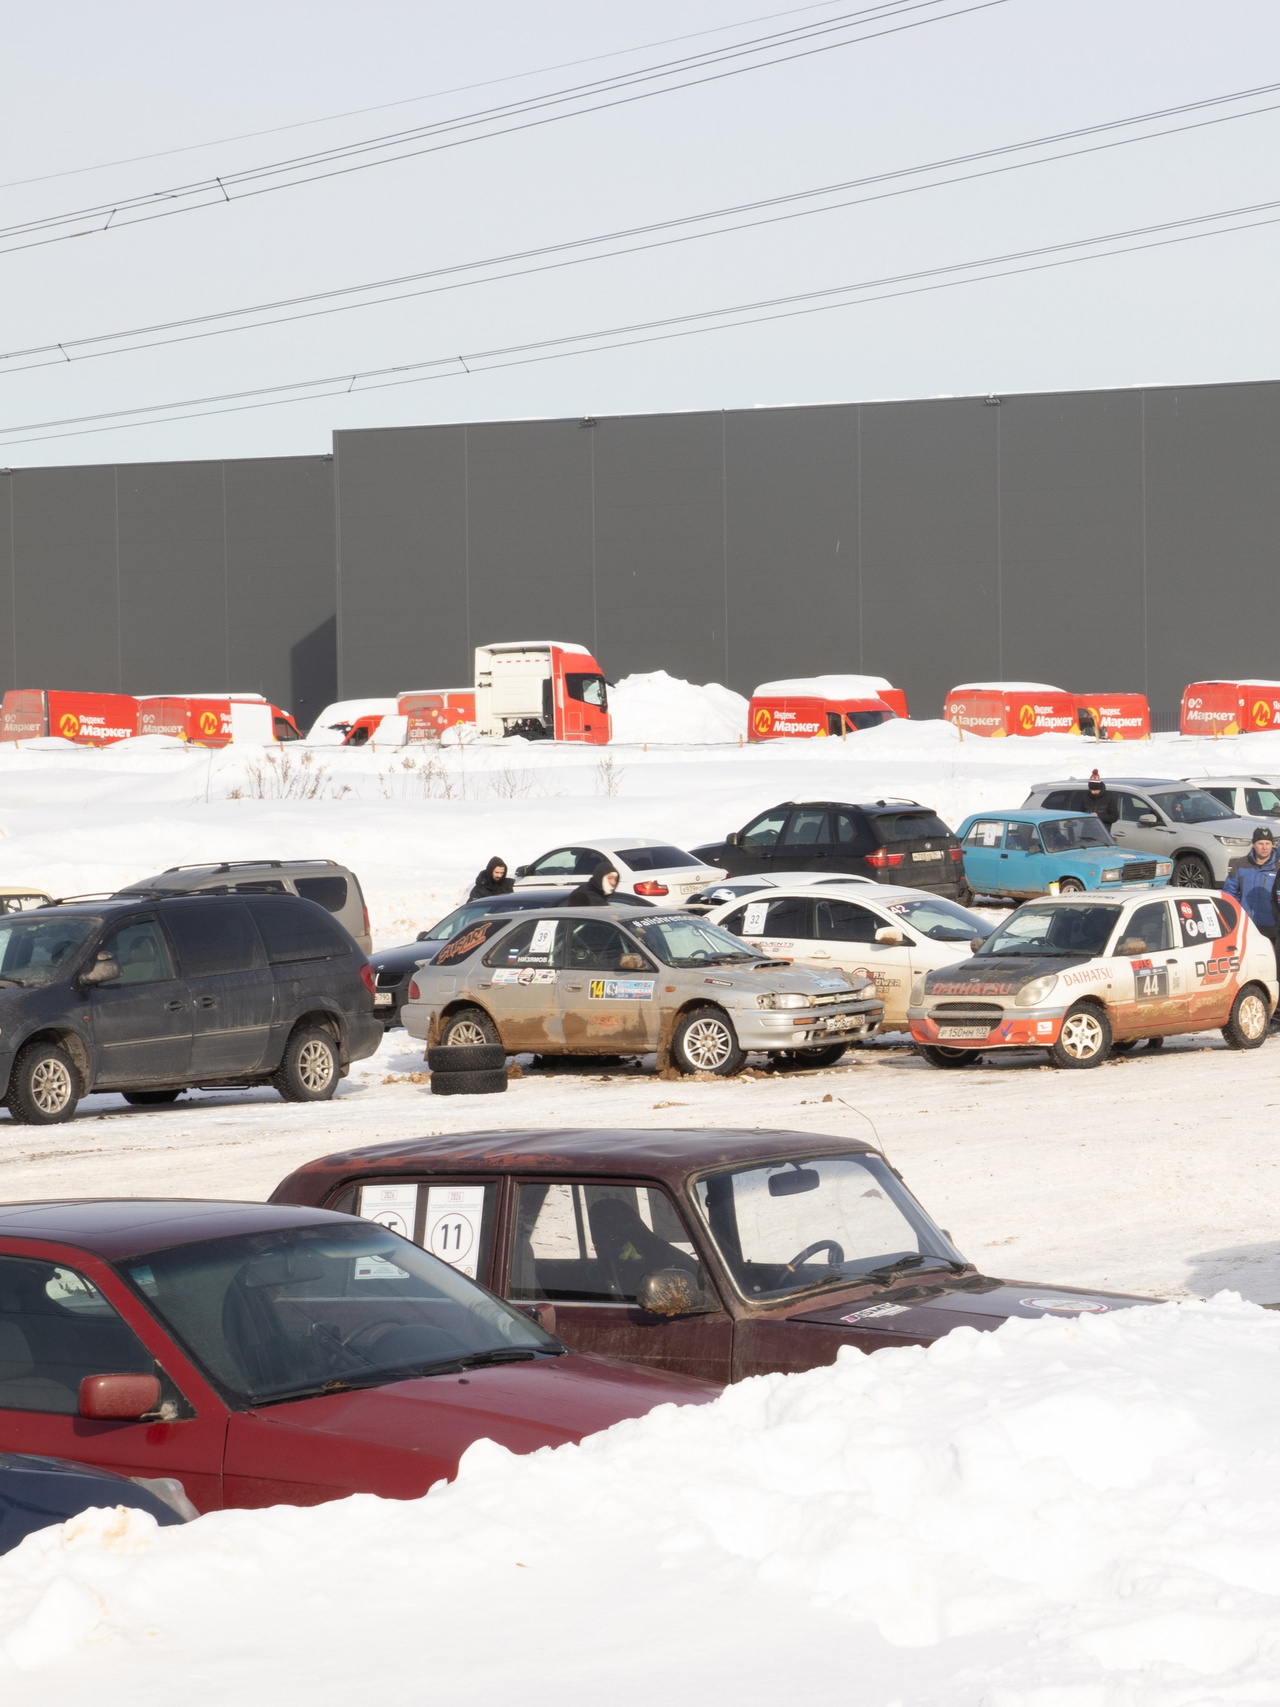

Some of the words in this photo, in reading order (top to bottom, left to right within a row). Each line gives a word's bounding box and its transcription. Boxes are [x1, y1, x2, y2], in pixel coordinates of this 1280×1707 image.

[1034, 705, 1054, 714] Яндекс
[79, 715, 105, 725] Яндекс
[773, 711, 796, 720] Яндекс
[1187, 711, 1235, 722] Маркет
[773, 721, 819, 733] Маркет
[1035, 715, 1073, 728] Маркет
[1100, 716, 1142, 728] Маркет
[4, 722, 41, 733] Маркет
[79, 725, 132, 738] Маркет
[142, 724, 183, 734] Маркет
[890, 904, 910, 914] 42
[750, 914, 761, 925] 32
[537, 932, 548, 943] 39
[1138, 960, 1151, 969] JAF
[1195, 956, 1240, 978] DCCS
[1063, 966, 1113, 987] DAIHATSU
[591, 980, 604, 998] 14
[931, 981, 1012, 995] DAIHATSU
[1143, 975, 1159, 996] 44
[441, 1223, 462, 1250] 11
